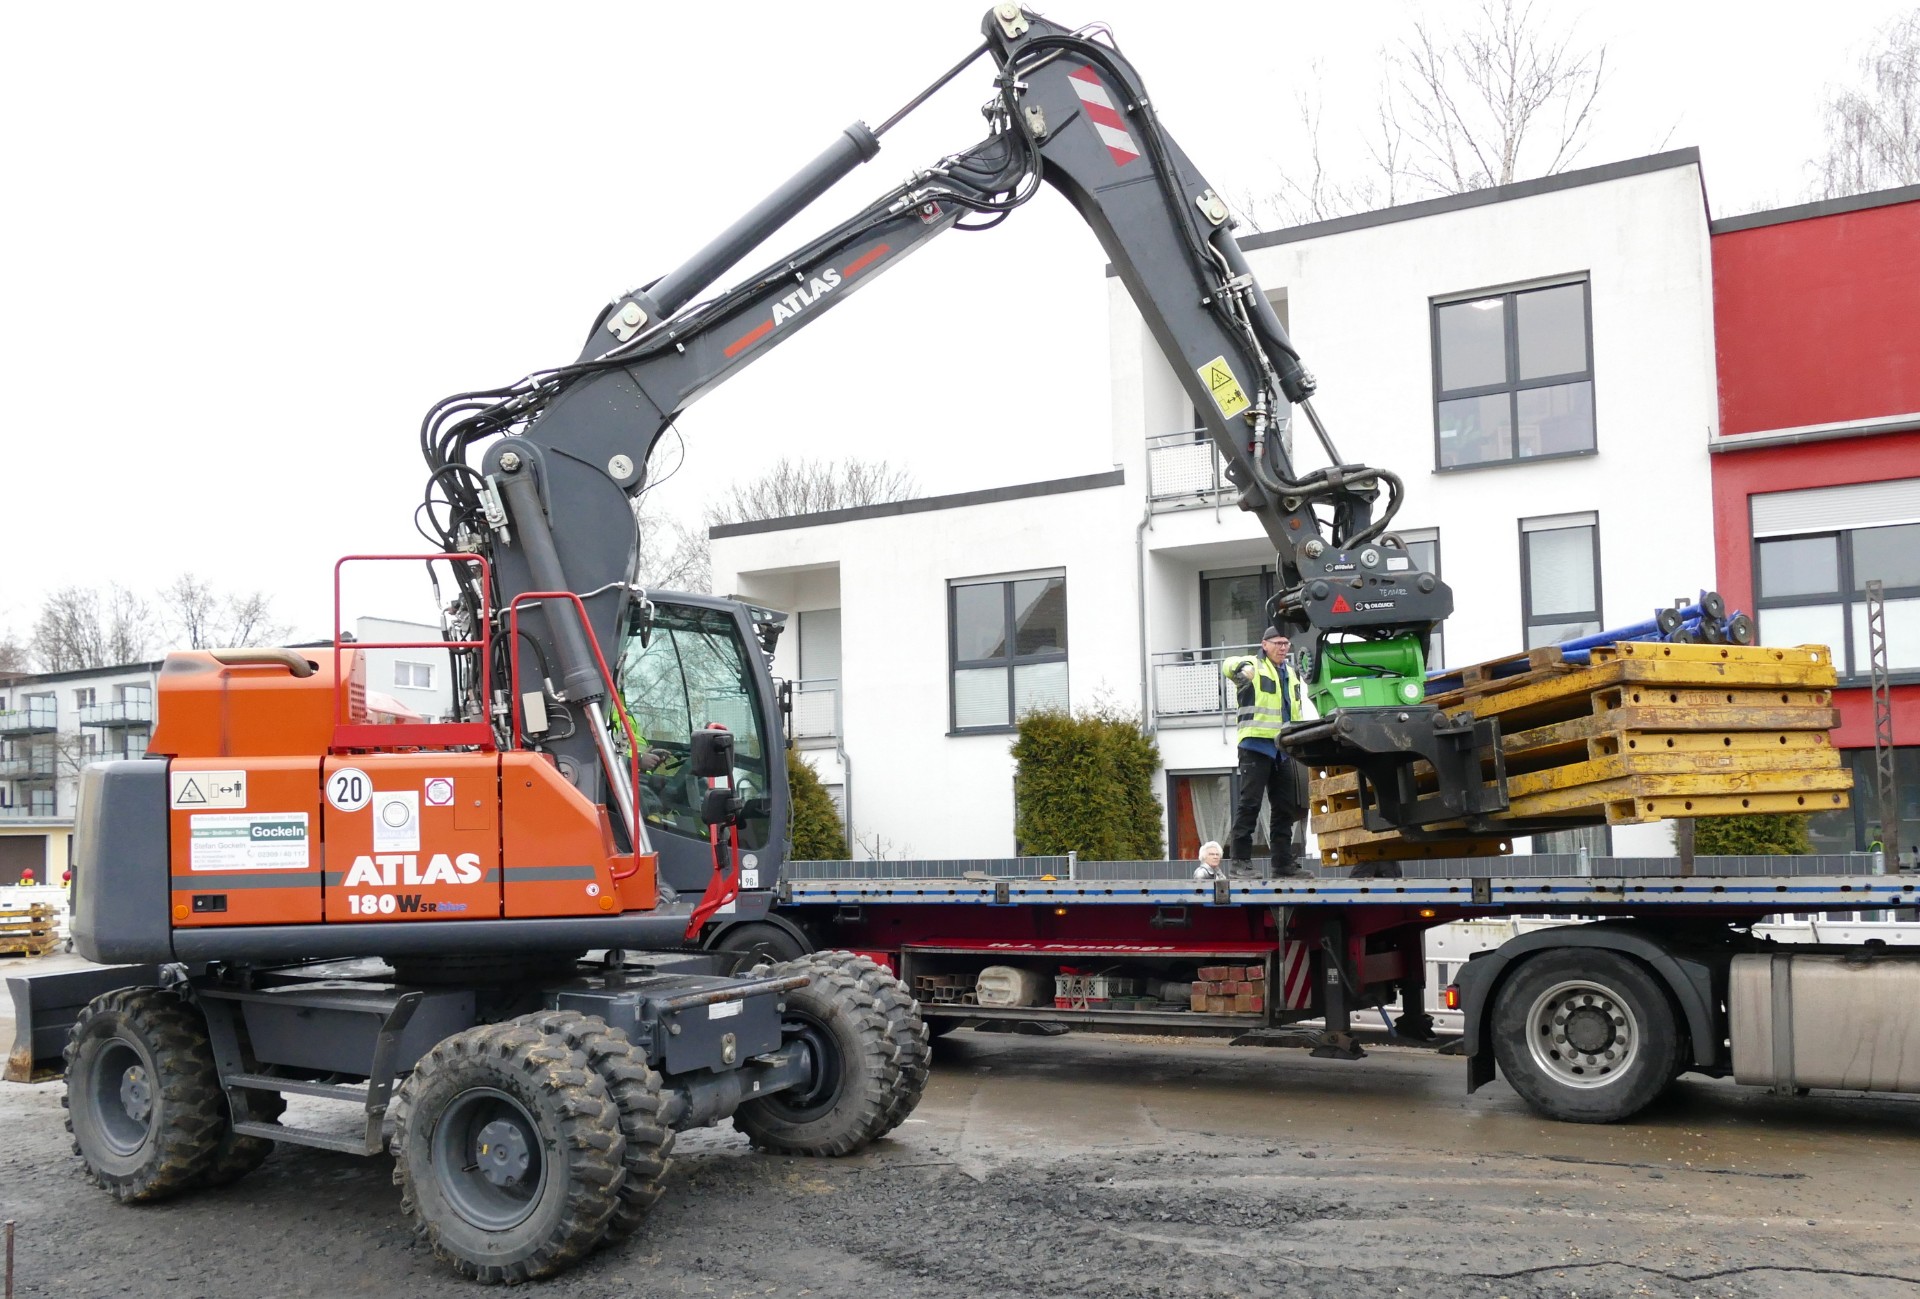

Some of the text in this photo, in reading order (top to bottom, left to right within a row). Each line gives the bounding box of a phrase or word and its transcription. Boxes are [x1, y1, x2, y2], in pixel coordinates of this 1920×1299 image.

[772, 268, 841, 326] ATLAS
[336, 776, 362, 803] 20
[252, 825, 304, 837] Gockeln
[194, 842, 216, 850] Stefan
[344, 853, 482, 886] ATLAS
[1043, 943, 1175, 951] Pennings
